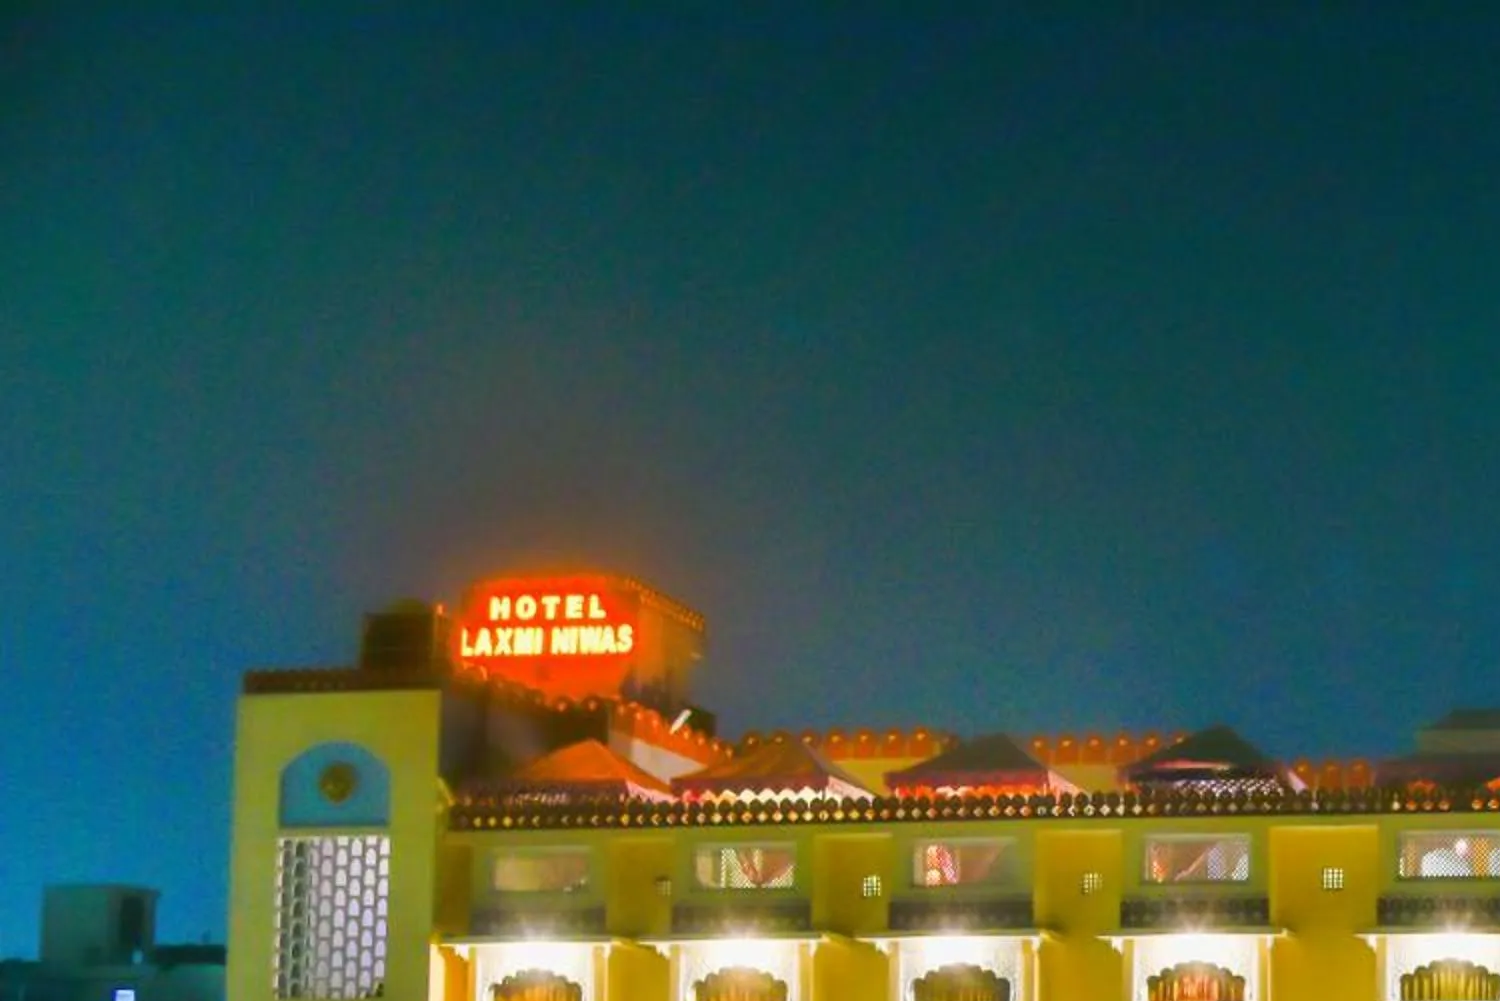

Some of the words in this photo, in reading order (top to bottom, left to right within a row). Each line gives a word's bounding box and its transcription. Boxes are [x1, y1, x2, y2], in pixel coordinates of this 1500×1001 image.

[489, 594, 607, 620] HOTEL
[460, 626, 543, 656] LAXMI
[551, 624, 633, 654] NIWAS
